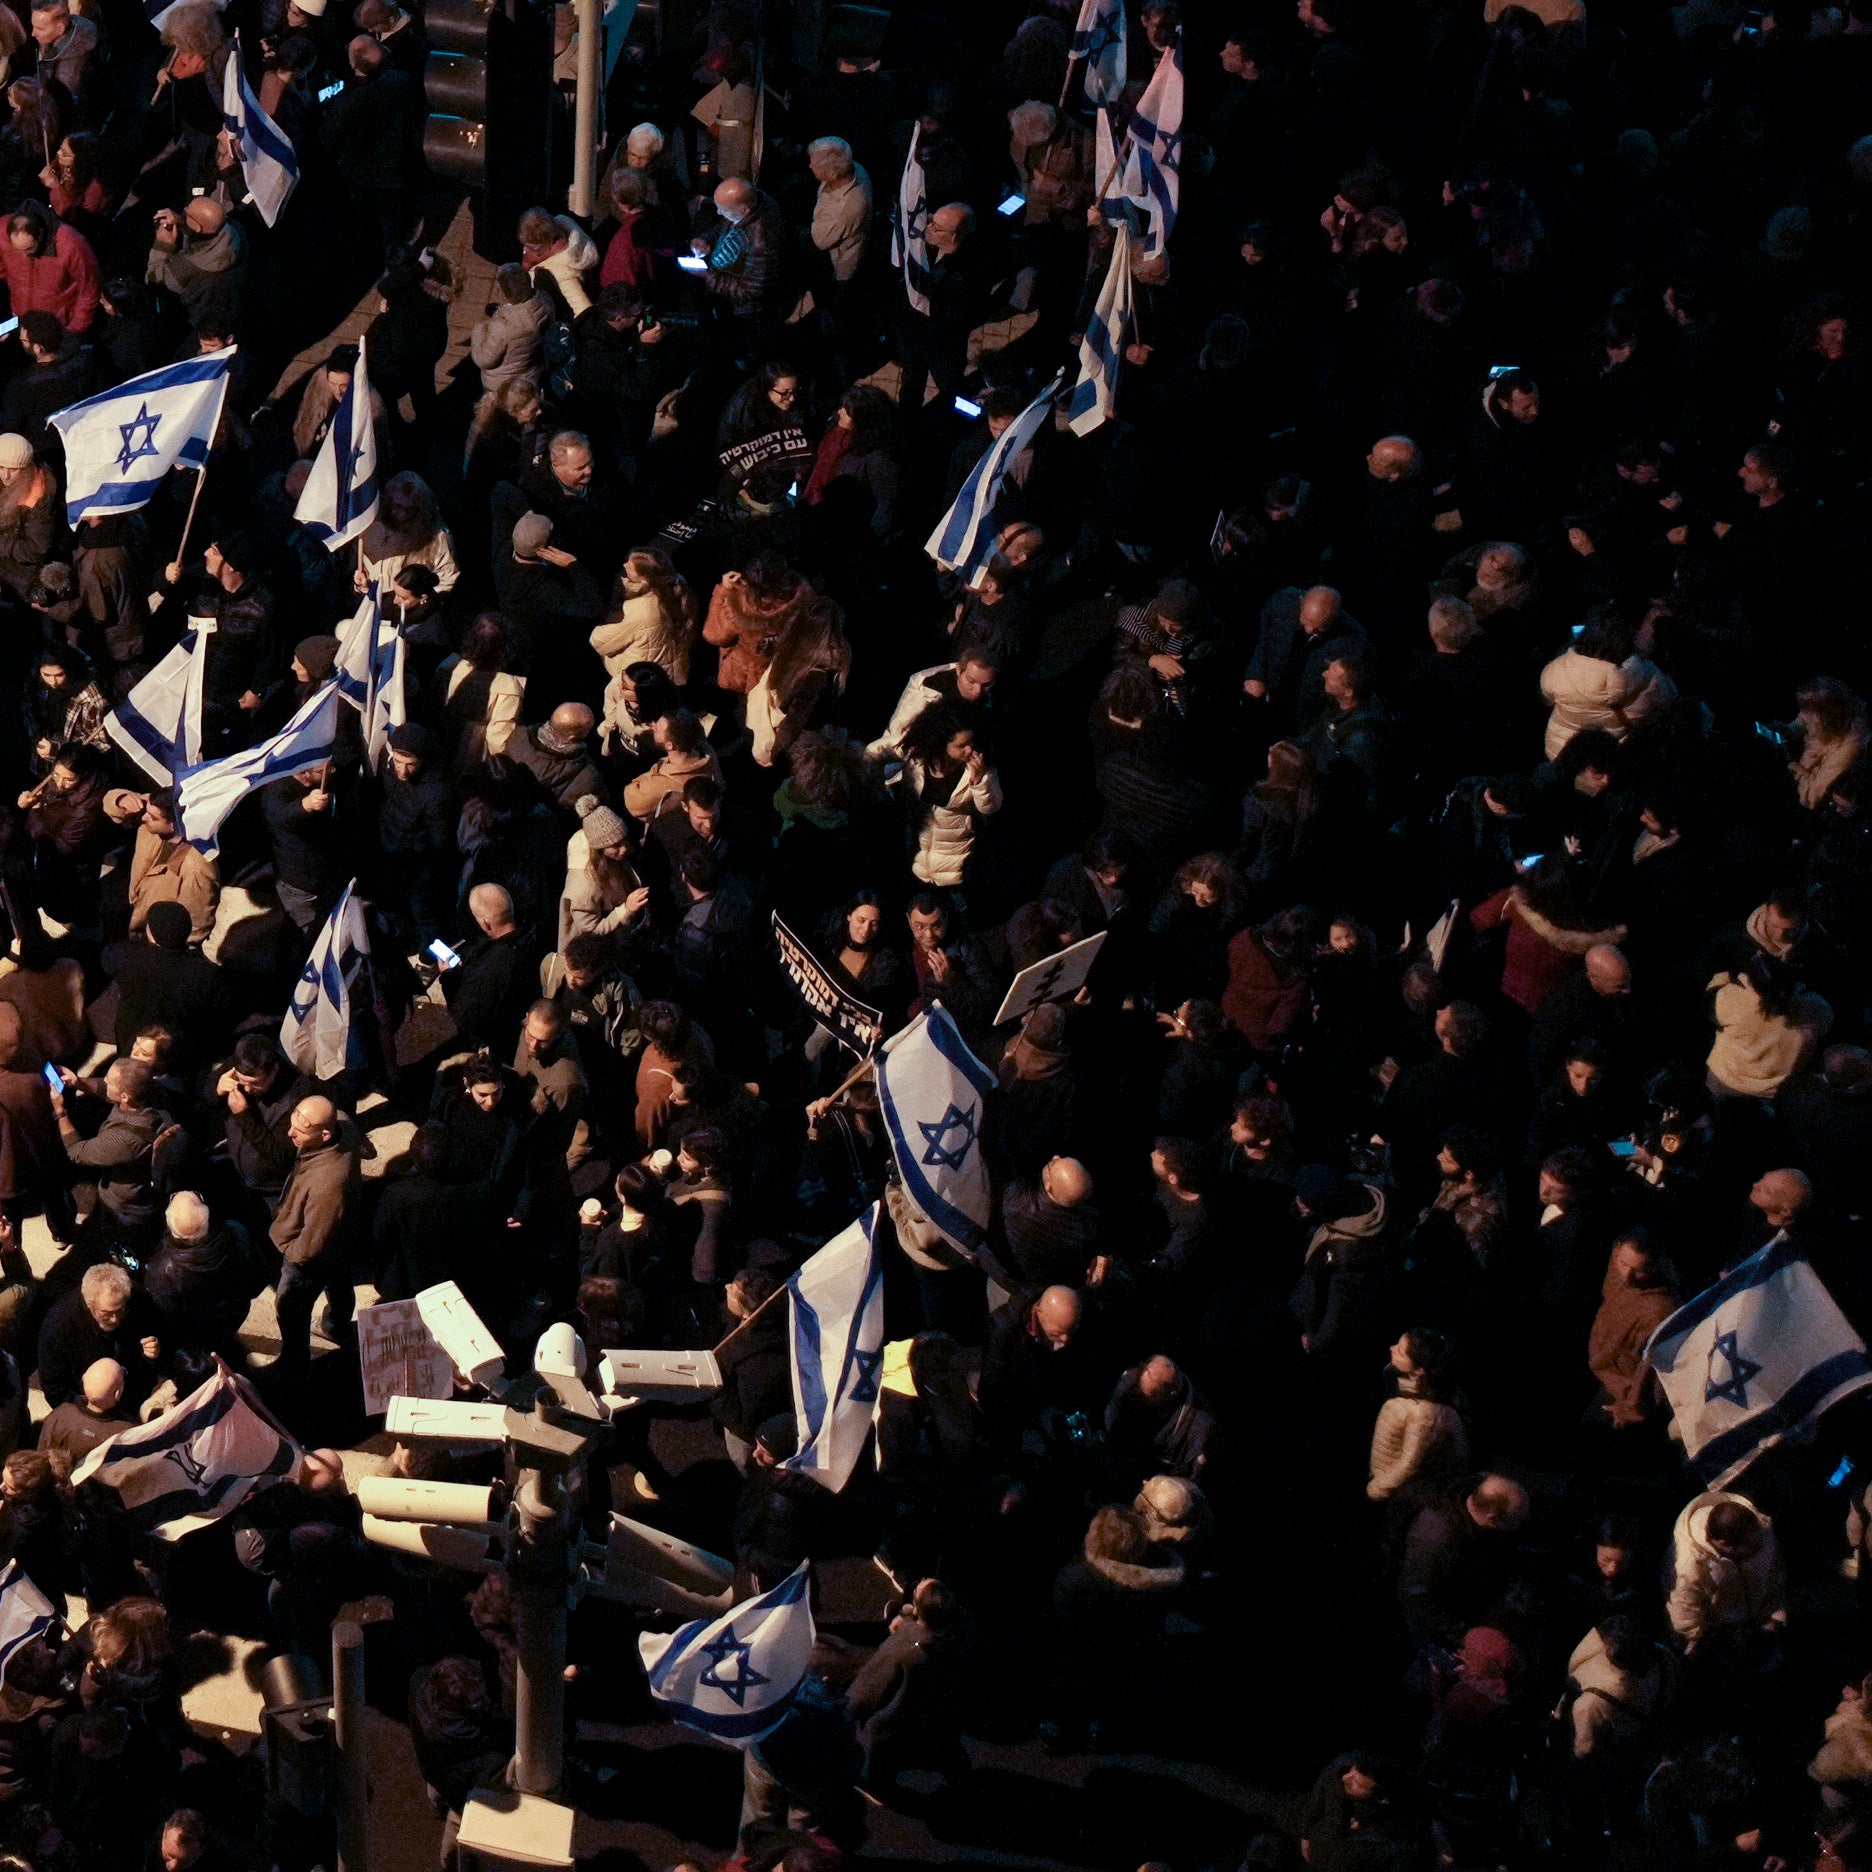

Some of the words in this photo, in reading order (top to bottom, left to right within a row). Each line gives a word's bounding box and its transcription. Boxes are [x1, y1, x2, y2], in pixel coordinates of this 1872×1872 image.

[782, 428, 804, 440] אין
[783, 437, 808, 451] עם
[719, 430, 782, 466] דמוקרטיה
[739, 443, 782, 471] כיבוש
